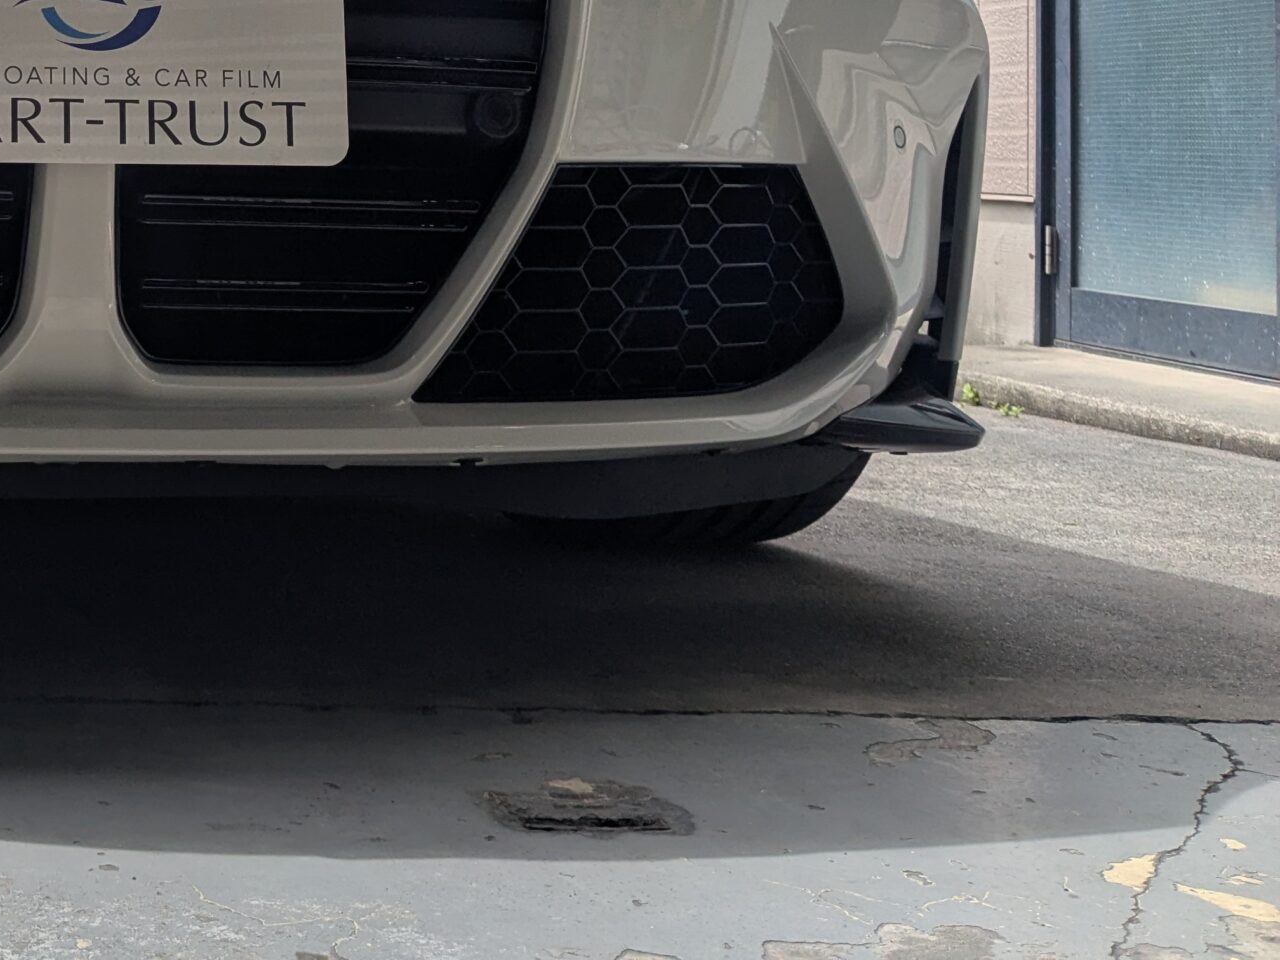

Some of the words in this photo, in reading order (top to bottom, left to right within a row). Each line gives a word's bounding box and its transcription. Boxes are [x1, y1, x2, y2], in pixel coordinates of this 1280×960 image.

[124, 67, 142, 87] &
[154, 67, 209, 88] CAR
[221, 68, 281, 89] FILM
